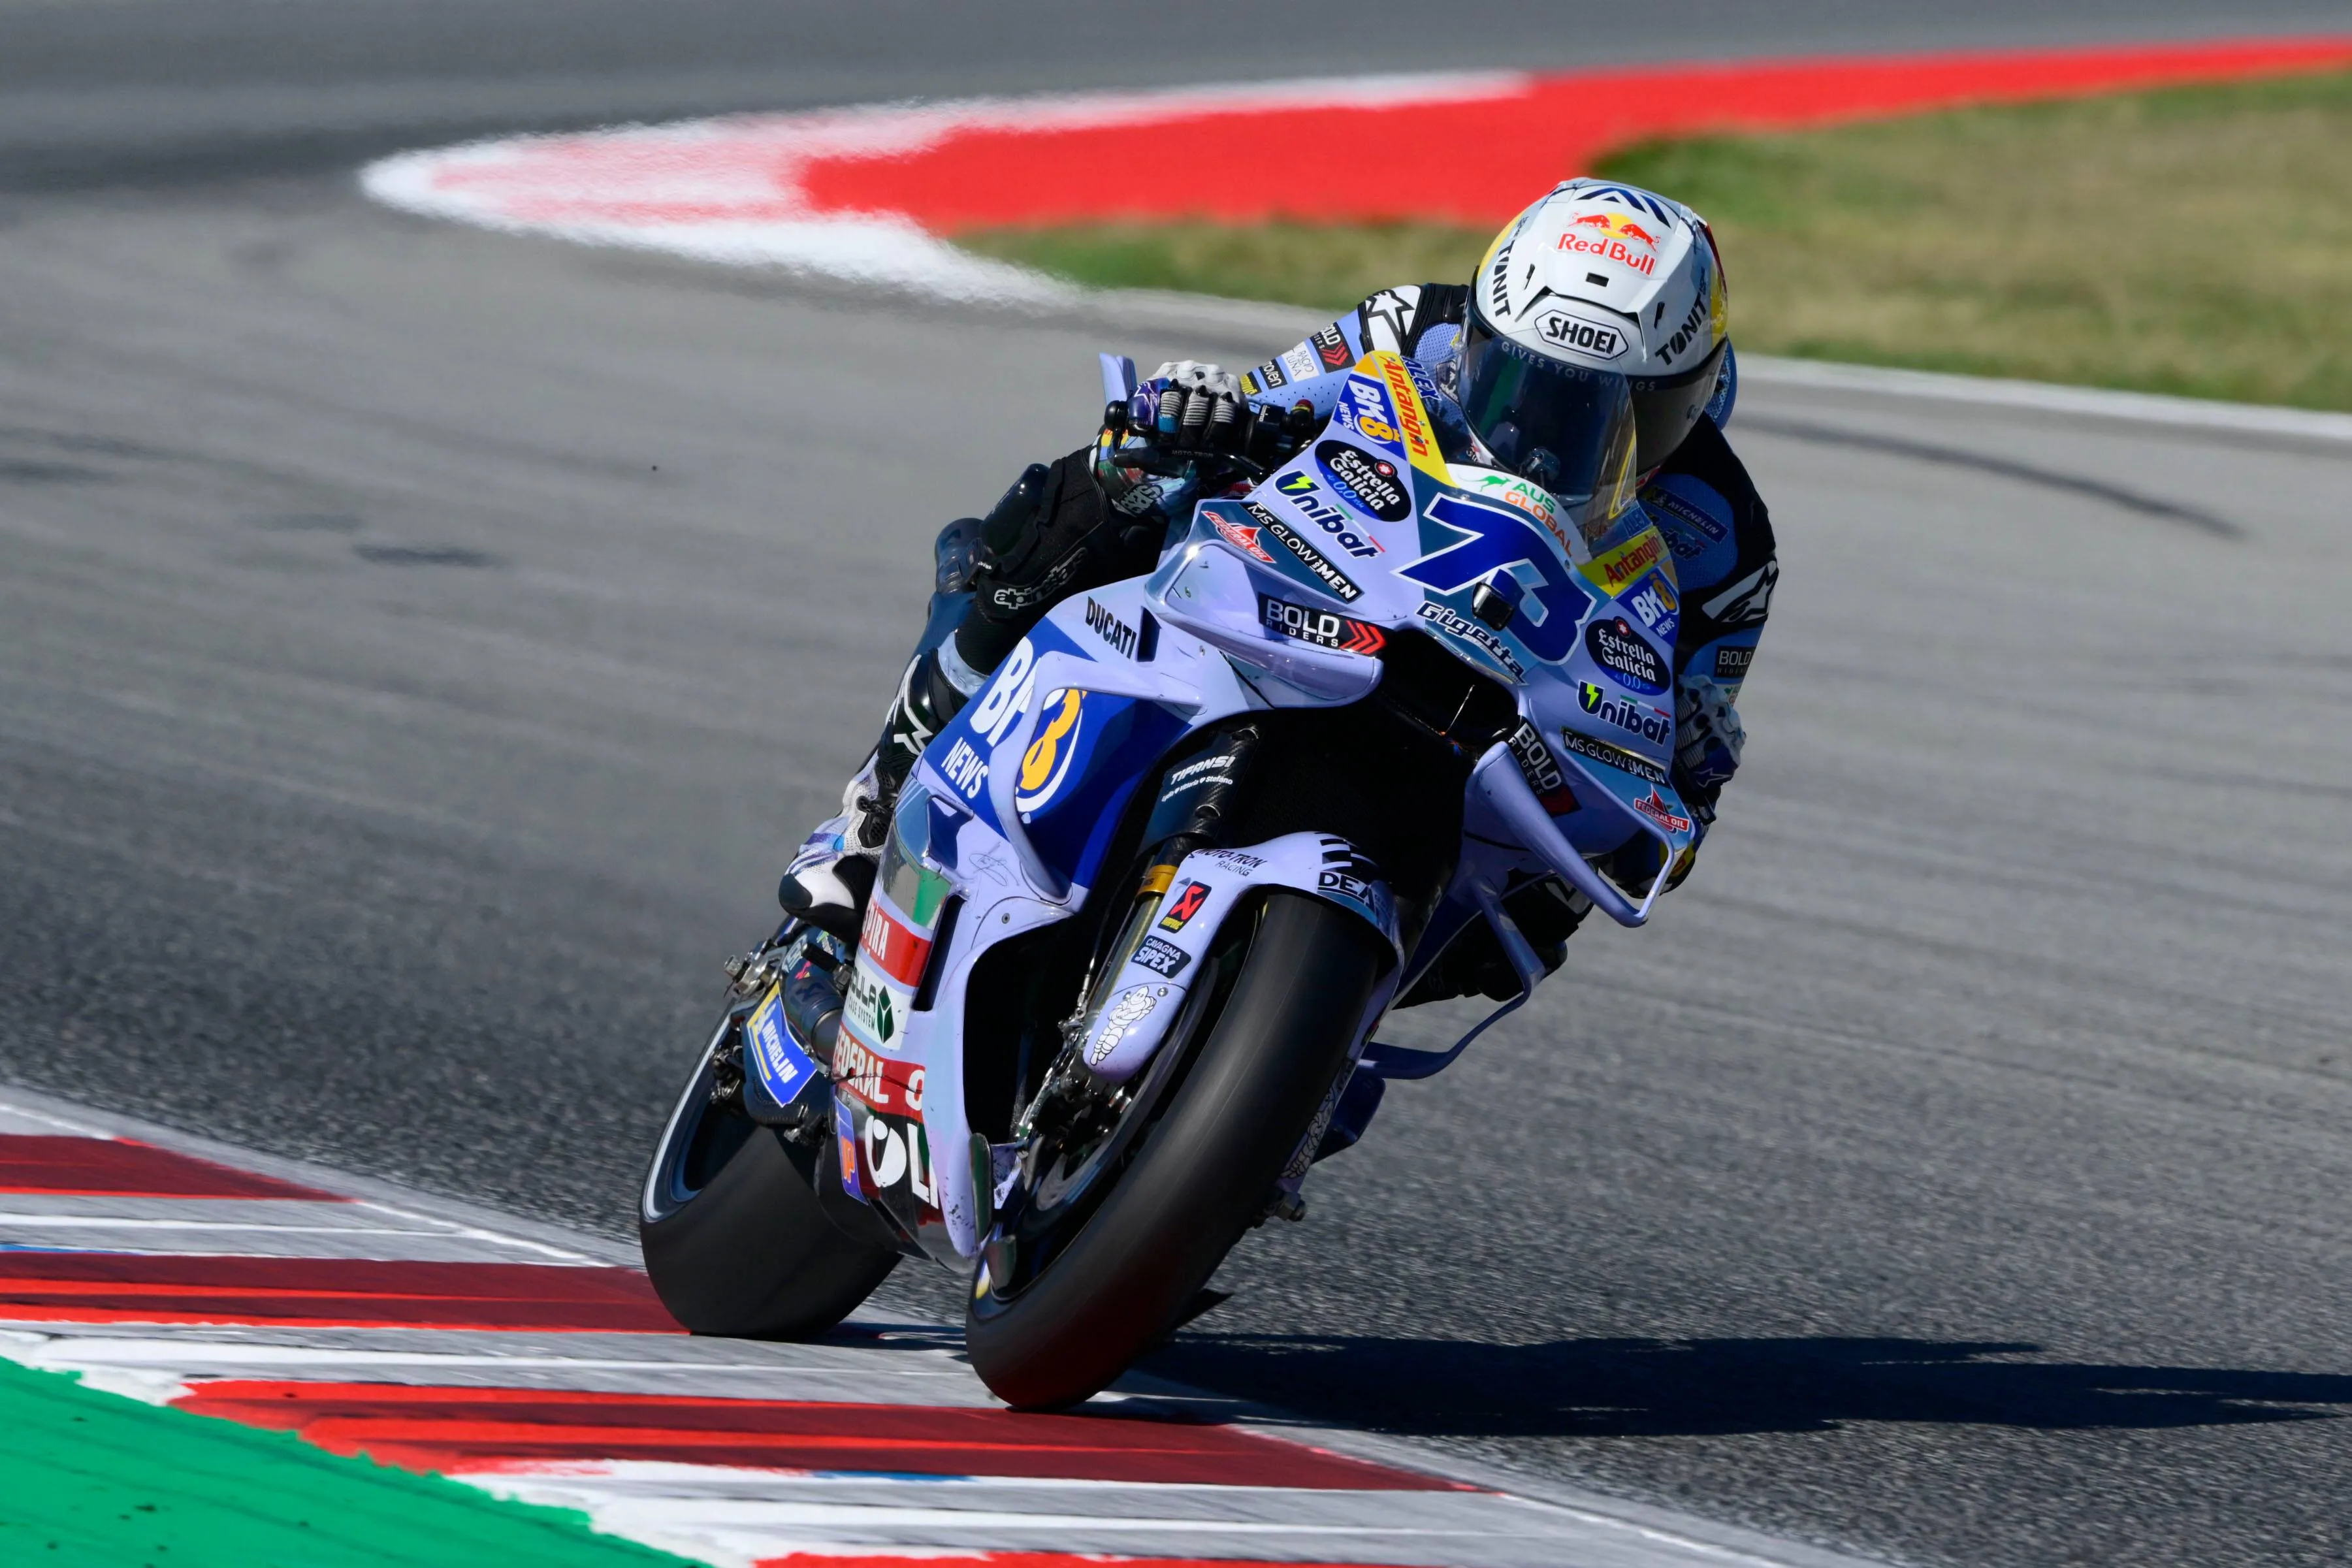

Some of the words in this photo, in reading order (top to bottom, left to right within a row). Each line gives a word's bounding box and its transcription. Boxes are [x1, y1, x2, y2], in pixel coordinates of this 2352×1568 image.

[1558, 232, 1605, 255] Red
[1608, 240, 1656, 276] Bull
[1546, 316, 1617, 355] SHOEI
[1286, 355, 1302, 377] LUNA
[1401, 356, 1442, 400] ALEX
[1502, 342, 1545, 368] GIVES
[1554, 364, 1588, 382] YOU
[1599, 376, 1656, 392] WINGS
[1337, 401, 1355, 430] NEWS
[1348, 379, 1396, 441] BK8
[1379, 356, 1429, 457] Antangin
[1330, 457, 1385, 510] Galicia
[1338, 450, 1400, 505] Estrella
[1512, 482, 1556, 515] AUS
[1275, 471, 1377, 558] Unibat
[1506, 491, 1573, 558] GLOBAL
[1667, 500, 1720, 535] MICHELIN
[1248, 504, 1273, 524] MS
[1270, 524, 1317, 562] GLOW
[1316, 564, 1357, 599] MEN
[1603, 535, 1662, 586] Antangin
[1266, 598, 1340, 639] BOLD
[1631, 579, 1676, 627] BK8
[1086, 596, 1137, 660] DUCATI
[1265, 620, 1339, 647] RIDERS
[1416, 601, 1528, 686] Gigetta
[1598, 628, 1655, 665] Estrella
[1656, 618, 1675, 637] NEWS
[1602, 647, 1656, 682] Galicia
[1719, 650, 1751, 665] BOLD
[1577, 680, 1671, 746] Unibat
[941, 737, 989, 799] NEWS
[1508, 737, 1544, 794] RIDERS
[1514, 722, 1562, 790] BOLD
[1565, 731, 1585, 752] MS
[1587, 743, 1626, 768] GLOW
[1633, 761, 1665, 784] MEN
[1206, 775, 1233, 785] Stefano
[1637, 801, 1669, 822] FEDERAL
[1671, 818, 1684, 828] OIL
[1216, 861, 1253, 876] RACING
[1135, 946, 1176, 974] SIPEX
[1146, 938, 1181, 961] CAVAGNA
[858, 1006, 875, 1031] SYSTEM
[761, 1017, 799, 1085] MICHELIN
